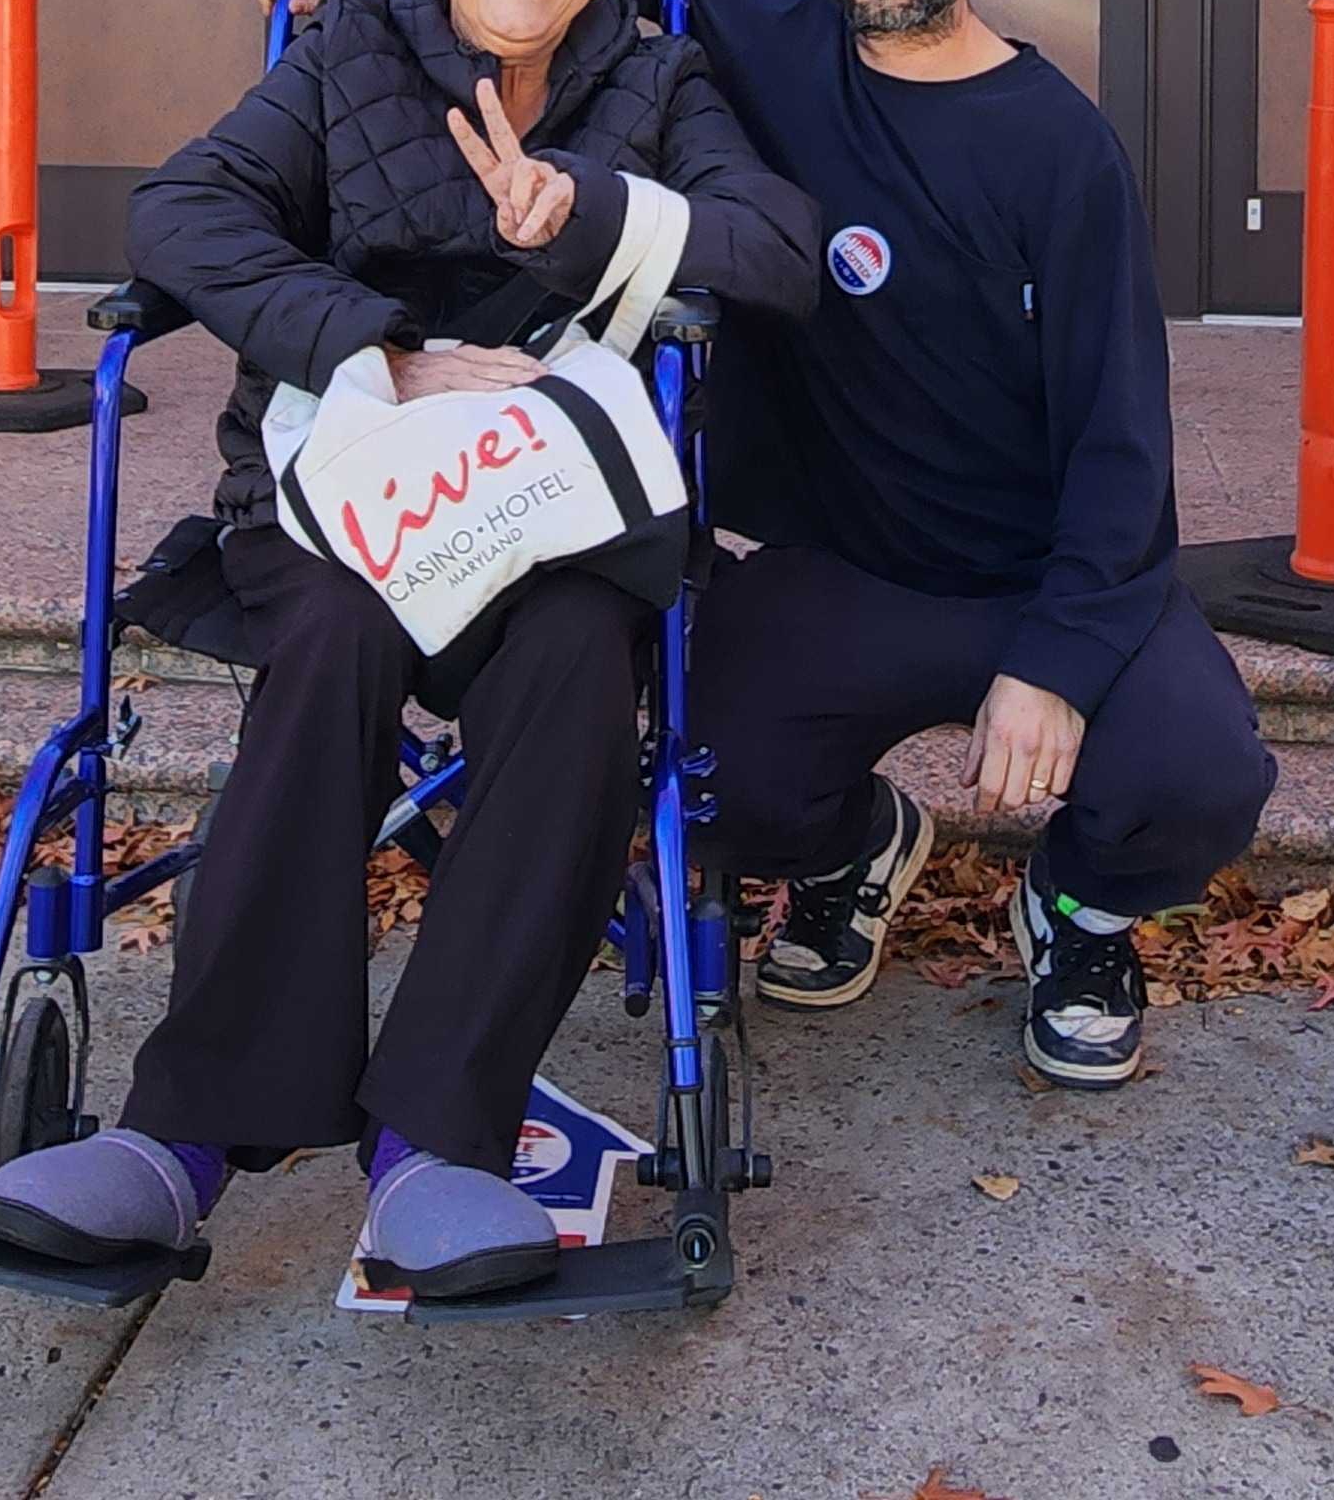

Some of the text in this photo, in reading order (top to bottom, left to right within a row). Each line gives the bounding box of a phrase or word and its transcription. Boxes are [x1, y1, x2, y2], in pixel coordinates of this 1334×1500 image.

[341, 402, 548, 582] Live!
[385, 470, 575, 602] CASINO HOTEL
[449, 527, 524, 589] MARYLAND
